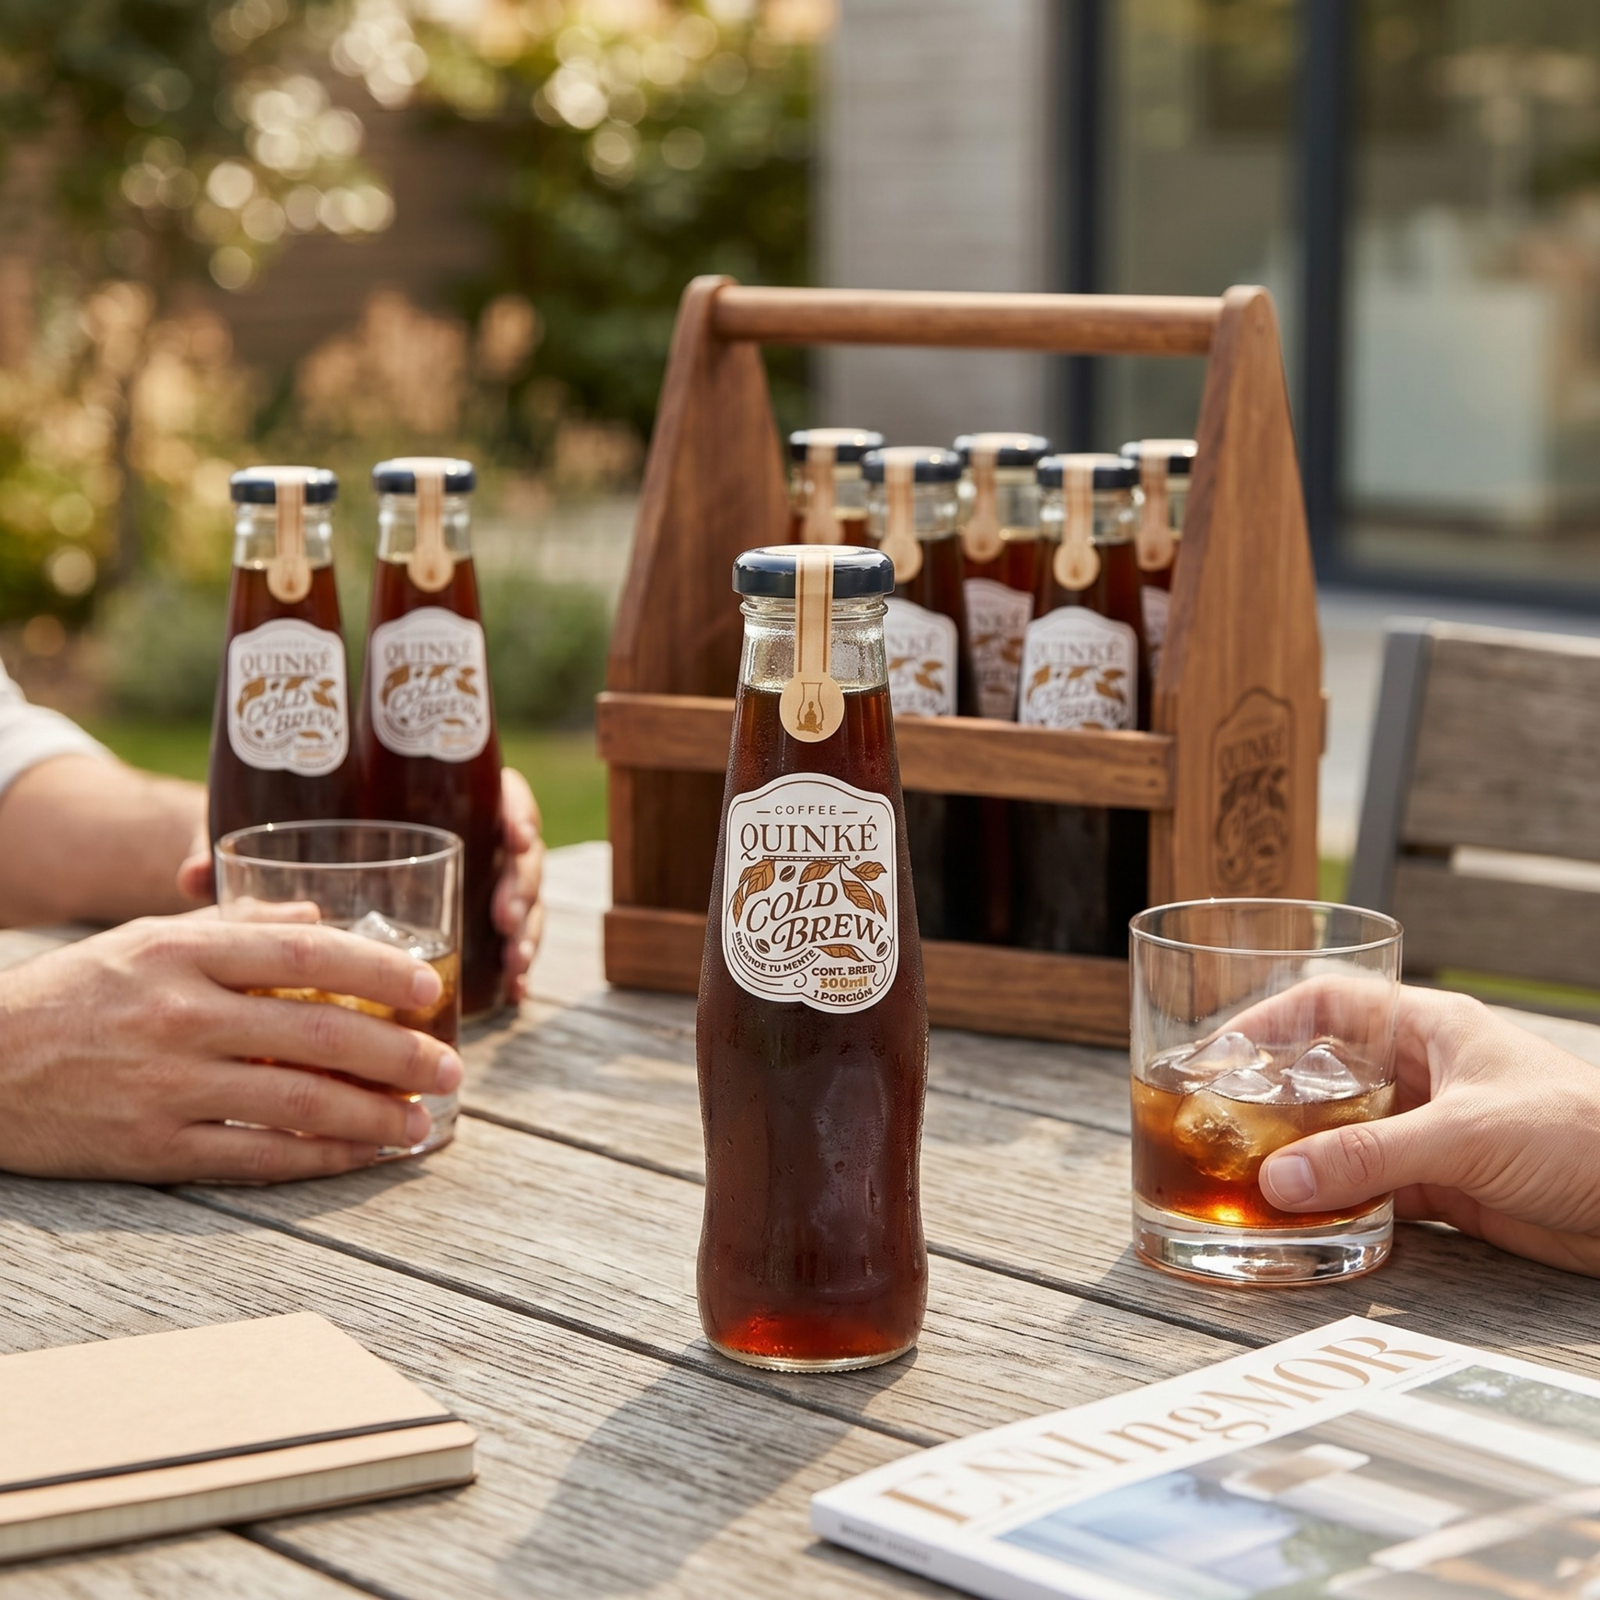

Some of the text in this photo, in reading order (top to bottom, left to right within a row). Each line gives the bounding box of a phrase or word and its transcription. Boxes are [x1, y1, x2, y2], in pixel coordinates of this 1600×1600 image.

[240, 646, 331, 678] QUINKÉ
[246, 688, 310, 725] COLD
[263, 708, 337, 735] BREW
[775, 805, 837, 816] COFFEE
[740, 815, 879, 861] QUINKÉ
[745, 881, 838, 933] COLD
[771, 913, 884, 953] BREW
[768, 964, 781, 973] TU
[783, 949, 816, 972] MENTE
[811, 966, 846, 977] CONT.
[813, 987, 874, 1003] 1 PORCIÓN
